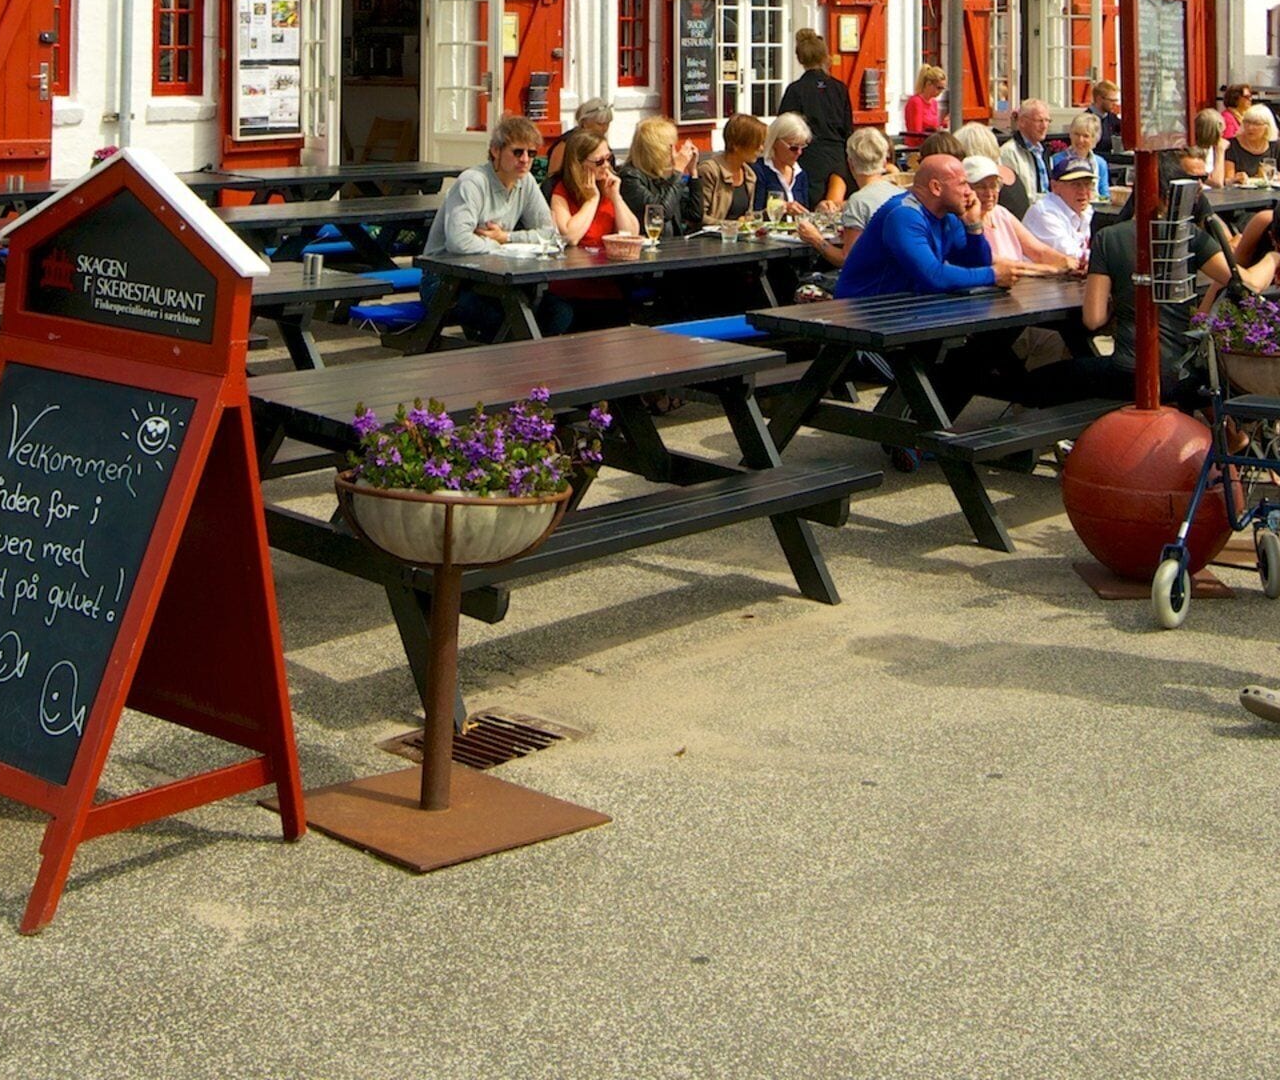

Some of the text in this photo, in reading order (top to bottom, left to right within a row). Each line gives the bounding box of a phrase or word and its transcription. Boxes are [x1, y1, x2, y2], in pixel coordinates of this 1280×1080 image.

[76, 254, 128, 278] SKAGEN
[94, 298, 159, 320] Fiskespecialiteter
[164, 311, 201, 327] særklasse
[45, 490, 80, 528] for
[42, 539, 90, 579] med
[11, 573, 38, 616] på
